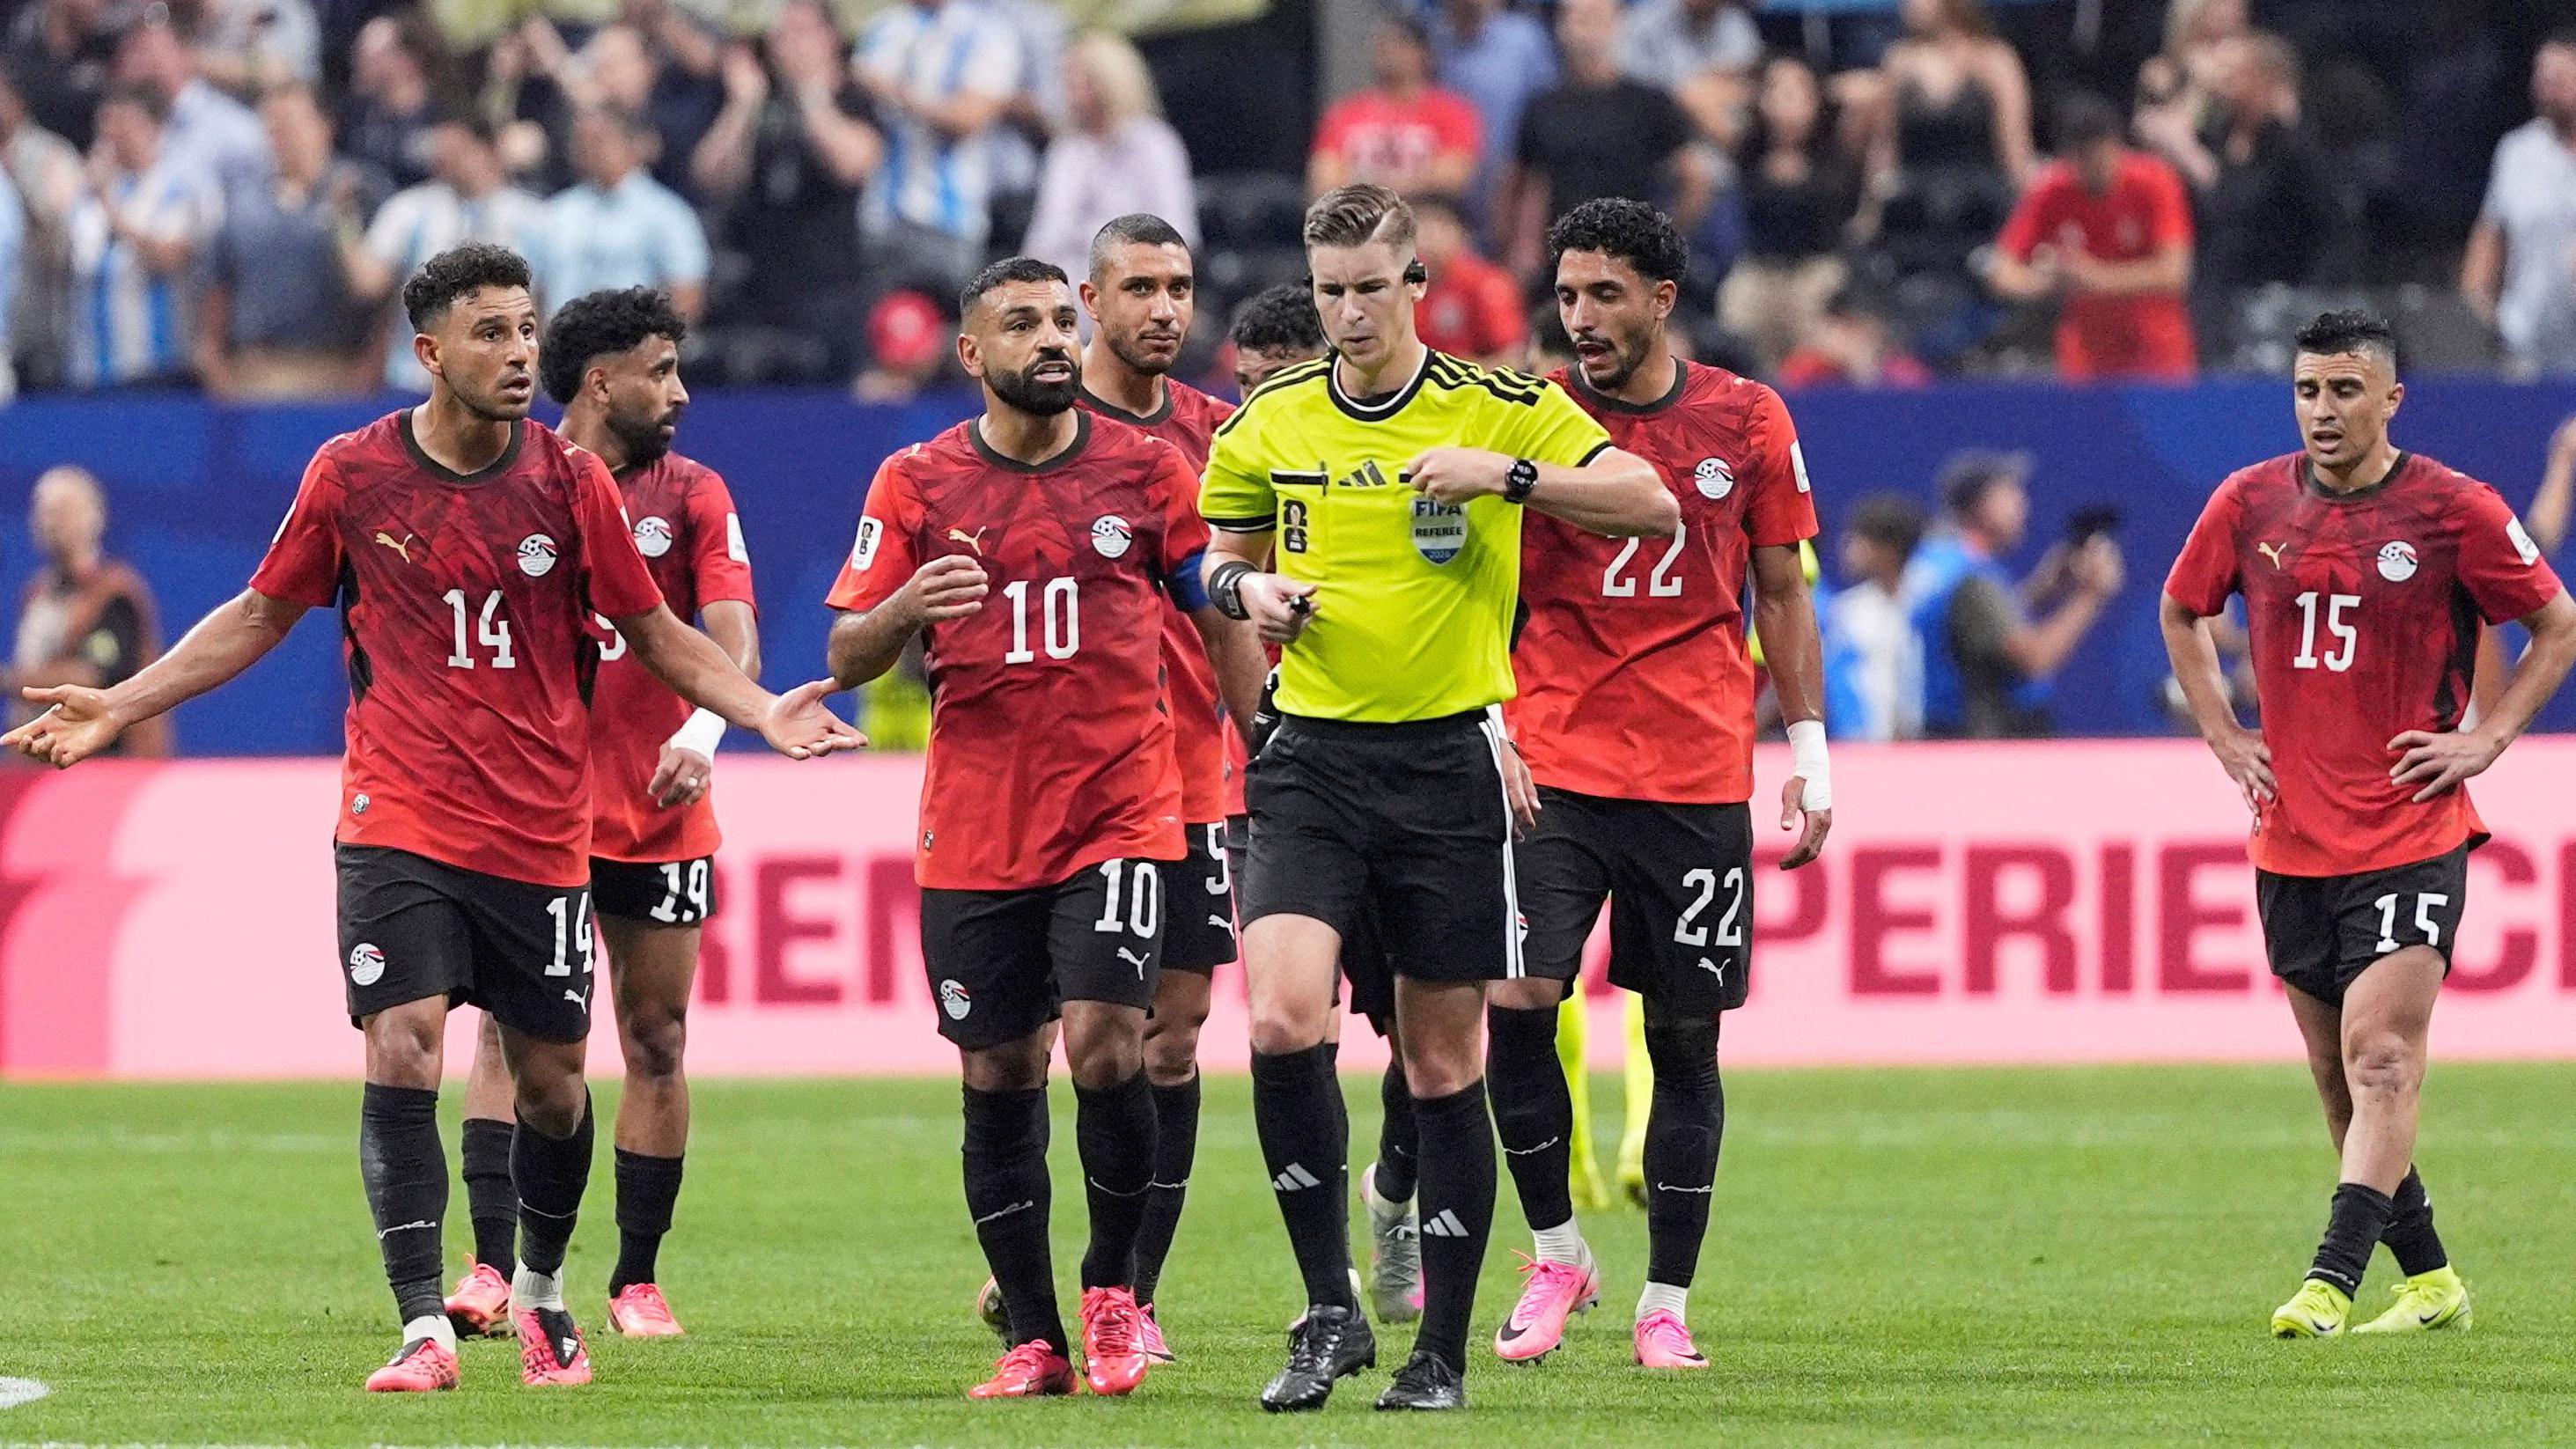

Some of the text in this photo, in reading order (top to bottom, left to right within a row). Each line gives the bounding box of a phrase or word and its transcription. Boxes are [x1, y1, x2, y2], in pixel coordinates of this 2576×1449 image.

[1415, 500, 1462, 518] FIFA
[1415, 526, 1463, 538] REFEREE
[1601, 518, 1687, 598] 22
[442, 589, 516, 669] 14
[1003, 576, 1079, 665] 10
[2293, 591, 2361, 672] 15
[650, 859, 709, 923] 19
[1094, 857, 1158, 939] 10
[1205, 821, 1231, 895] 5
[544, 891, 593, 976] 14
[1585, 840, 2576, 998] PERIEC
[1674, 866, 1743, 947] 22
[2374, 893, 2448, 953] 15
